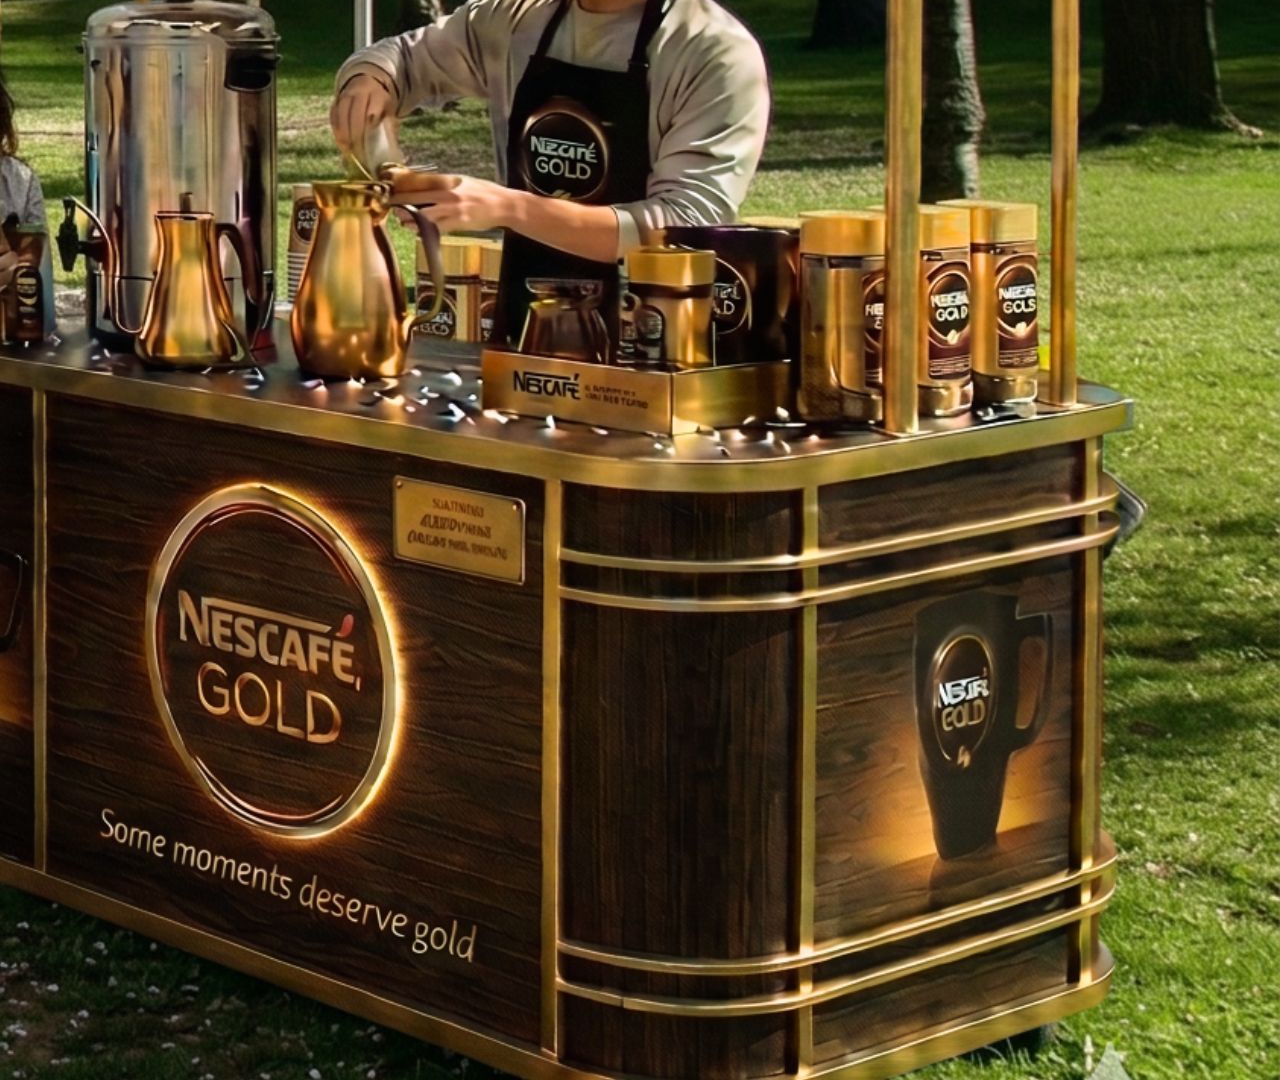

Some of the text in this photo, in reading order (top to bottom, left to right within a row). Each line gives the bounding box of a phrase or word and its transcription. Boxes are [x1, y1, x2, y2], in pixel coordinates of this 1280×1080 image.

[535, 156, 591, 180] GOLD
[197, 661, 342, 745] GOLD
[99, 807, 478, 963] Some moments deserve gold
